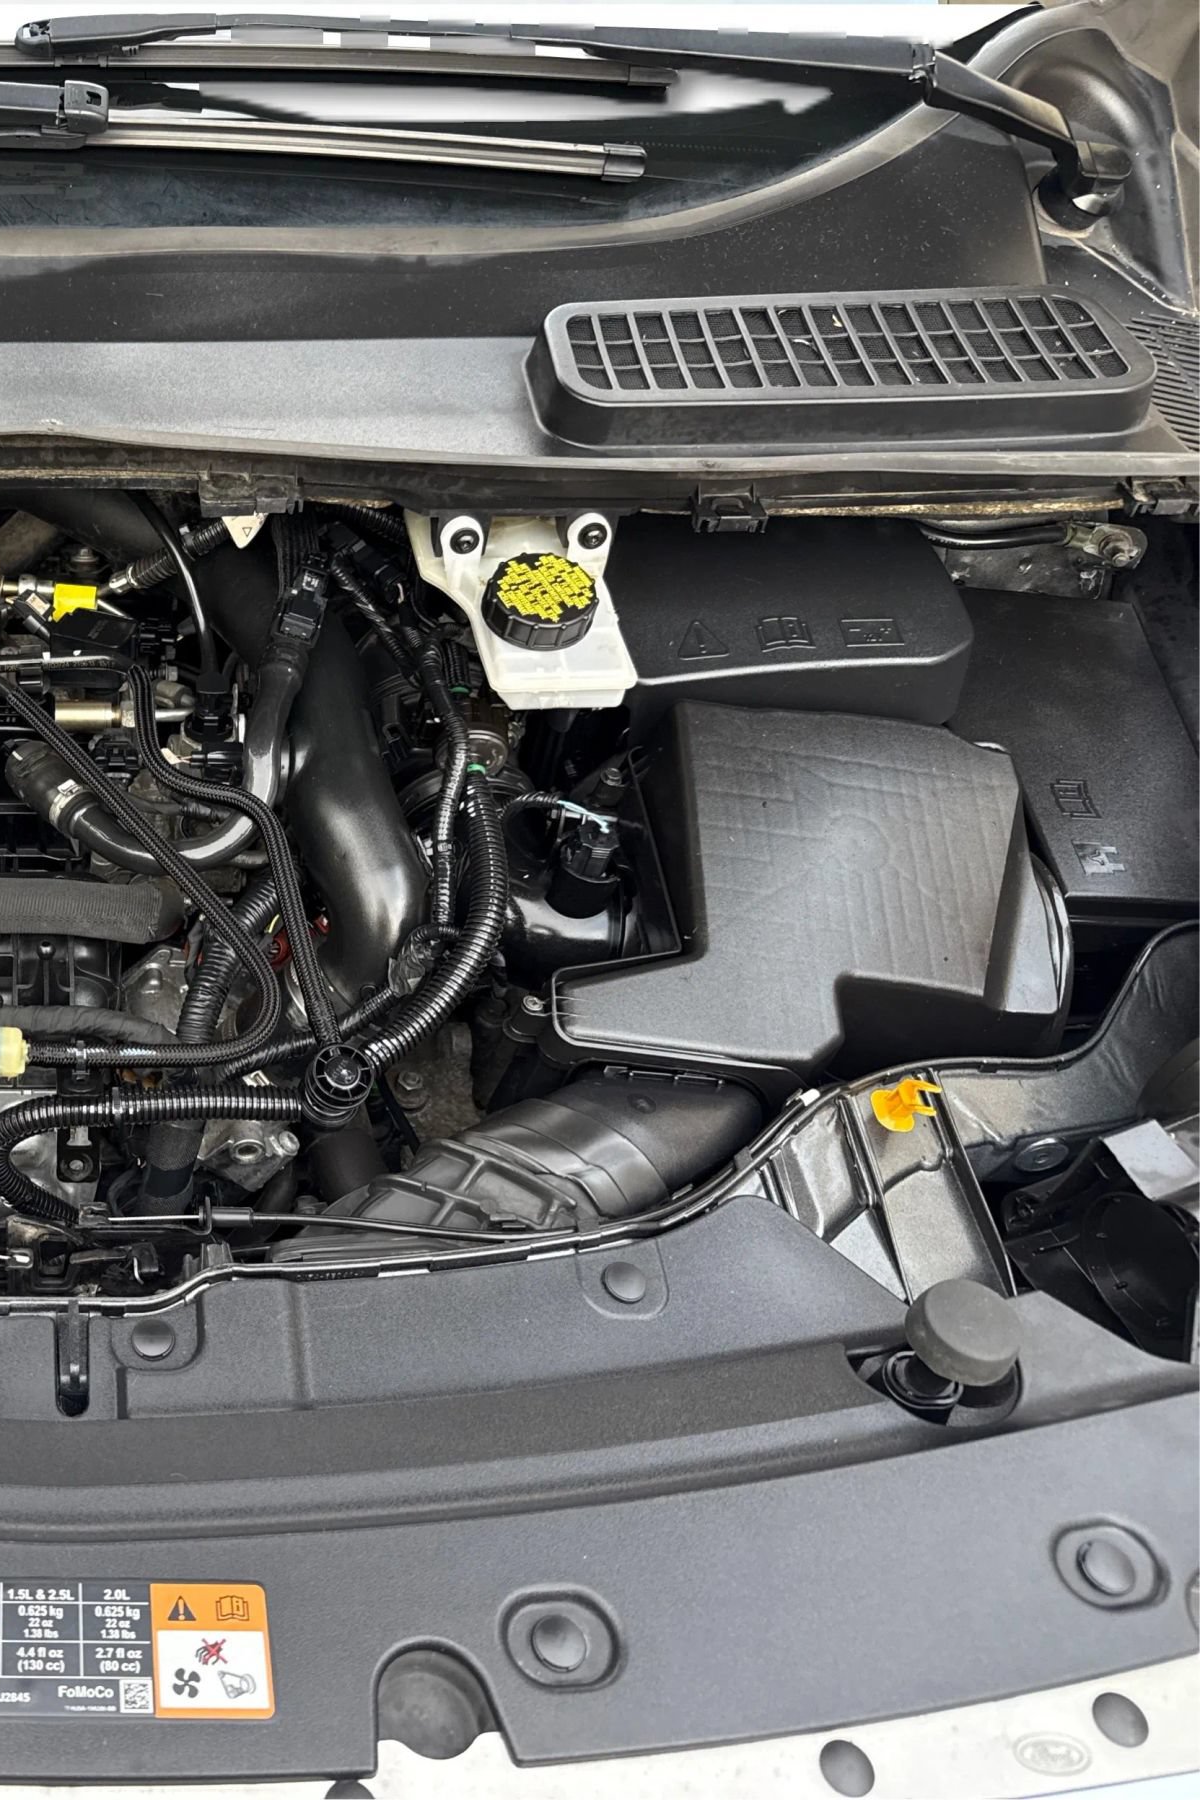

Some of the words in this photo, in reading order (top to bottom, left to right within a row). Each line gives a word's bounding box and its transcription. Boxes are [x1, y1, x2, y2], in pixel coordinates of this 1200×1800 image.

[7, 1588, 34, 1601] 1.5L
[35, 1589, 46, 1601] &
[48, 1589, 75, 1601] 2.5L
[103, 1589, 131, 1601] 2.0L
[18, 1605, 48, 1617] 0.625
[49, 1605, 64, 1619] kg
[94, 1606, 125, 1618] 0.625
[126, 1606, 141, 1620] kg
[28, 1618, 40, 1628] 22
[41, 1620, 54, 1628] oz
[105, 1618, 117, 1628] 22
[118, 1620, 131, 1628] oz
[23, 1628, 43, 1639] 1.38
[44, 1628, 59, 1639] lbs
[100, 1629, 120, 1639] 1.38
[121, 1629, 136, 1639] lbs
[16, 1647, 36, 1658] 4.4
[37, 1647, 46, 1658] fl
[48, 1649, 64, 1658] oz
[95, 1647, 113, 1659] 2.7
[115, 1647, 125, 1659] fl
[127, 1649, 143, 1659] oz
[17, 1660, 44, 1673] (130
[45, 1660, 65, 1673] cc)
[100, 1660, 119, 1674] (80
[121, 1660, 141, 1674] cc)
[57, 1685, 115, 1698] FoMoCo
